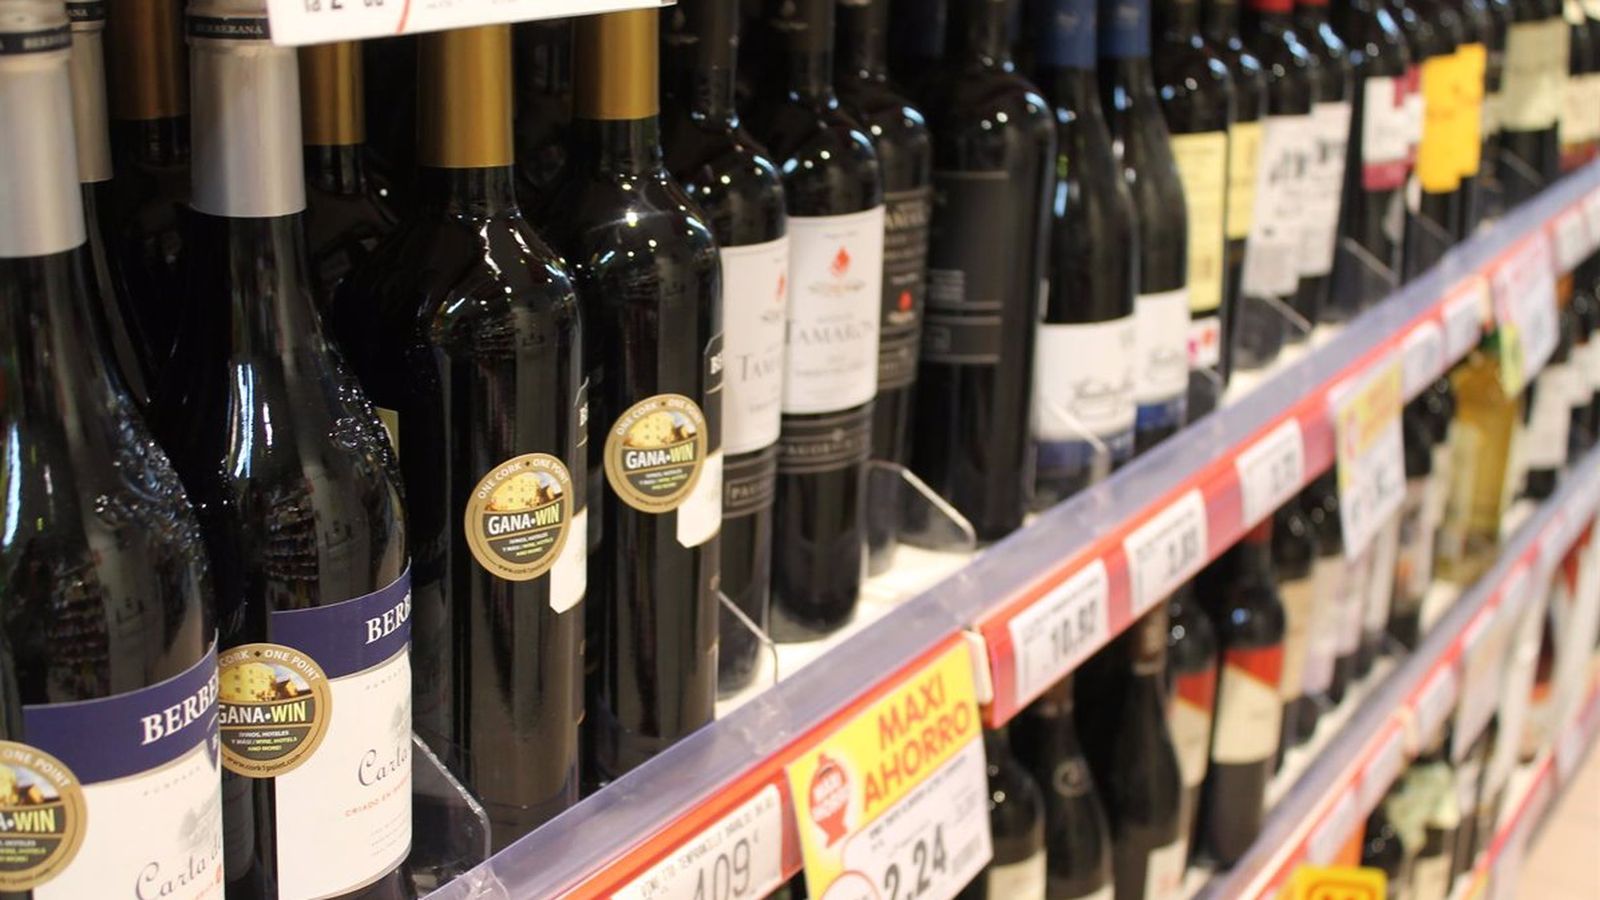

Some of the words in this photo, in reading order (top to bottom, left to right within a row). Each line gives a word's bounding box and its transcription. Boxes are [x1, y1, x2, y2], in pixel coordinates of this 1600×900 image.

[477, 479, 496, 500] ONE
[495, 461, 522, 481] CORK
[264, 650, 290, 663] ONE
[291, 658, 320, 681] POINT
[879, 672, 946, 751] MAXI
[864, 701, 971, 813] AHORRO
